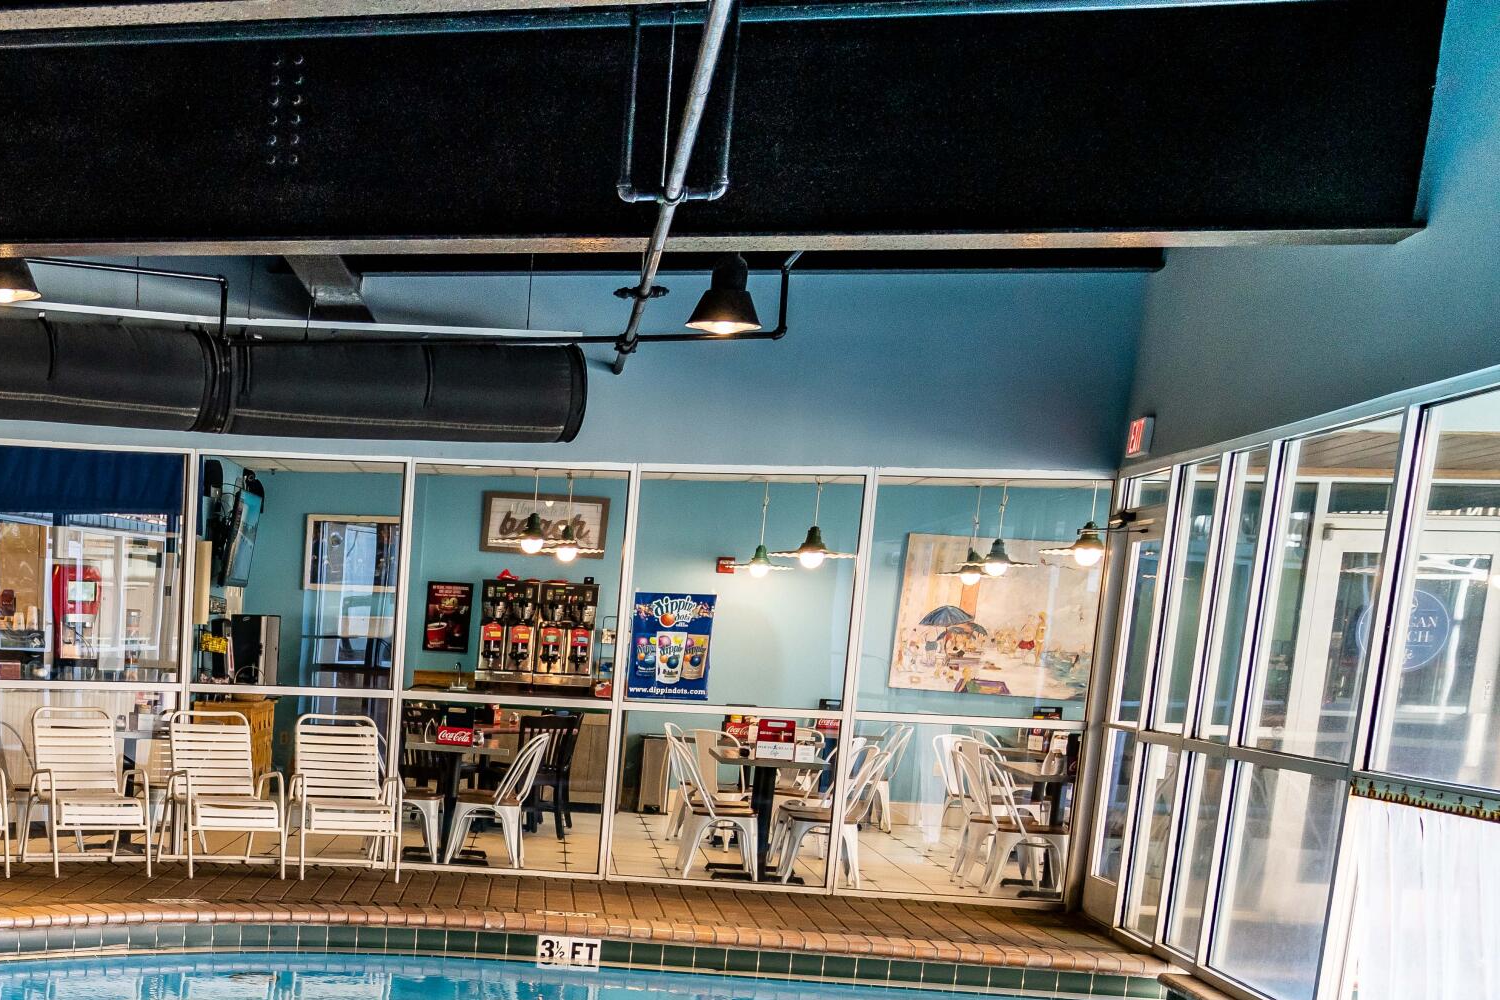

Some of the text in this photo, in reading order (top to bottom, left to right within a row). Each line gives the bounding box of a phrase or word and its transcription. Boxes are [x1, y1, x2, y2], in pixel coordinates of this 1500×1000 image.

[1128, 419, 1145, 453] EXIT
[629, 686, 706, 696] www.dippindots.com
[570, 942, 598, 967] FT
